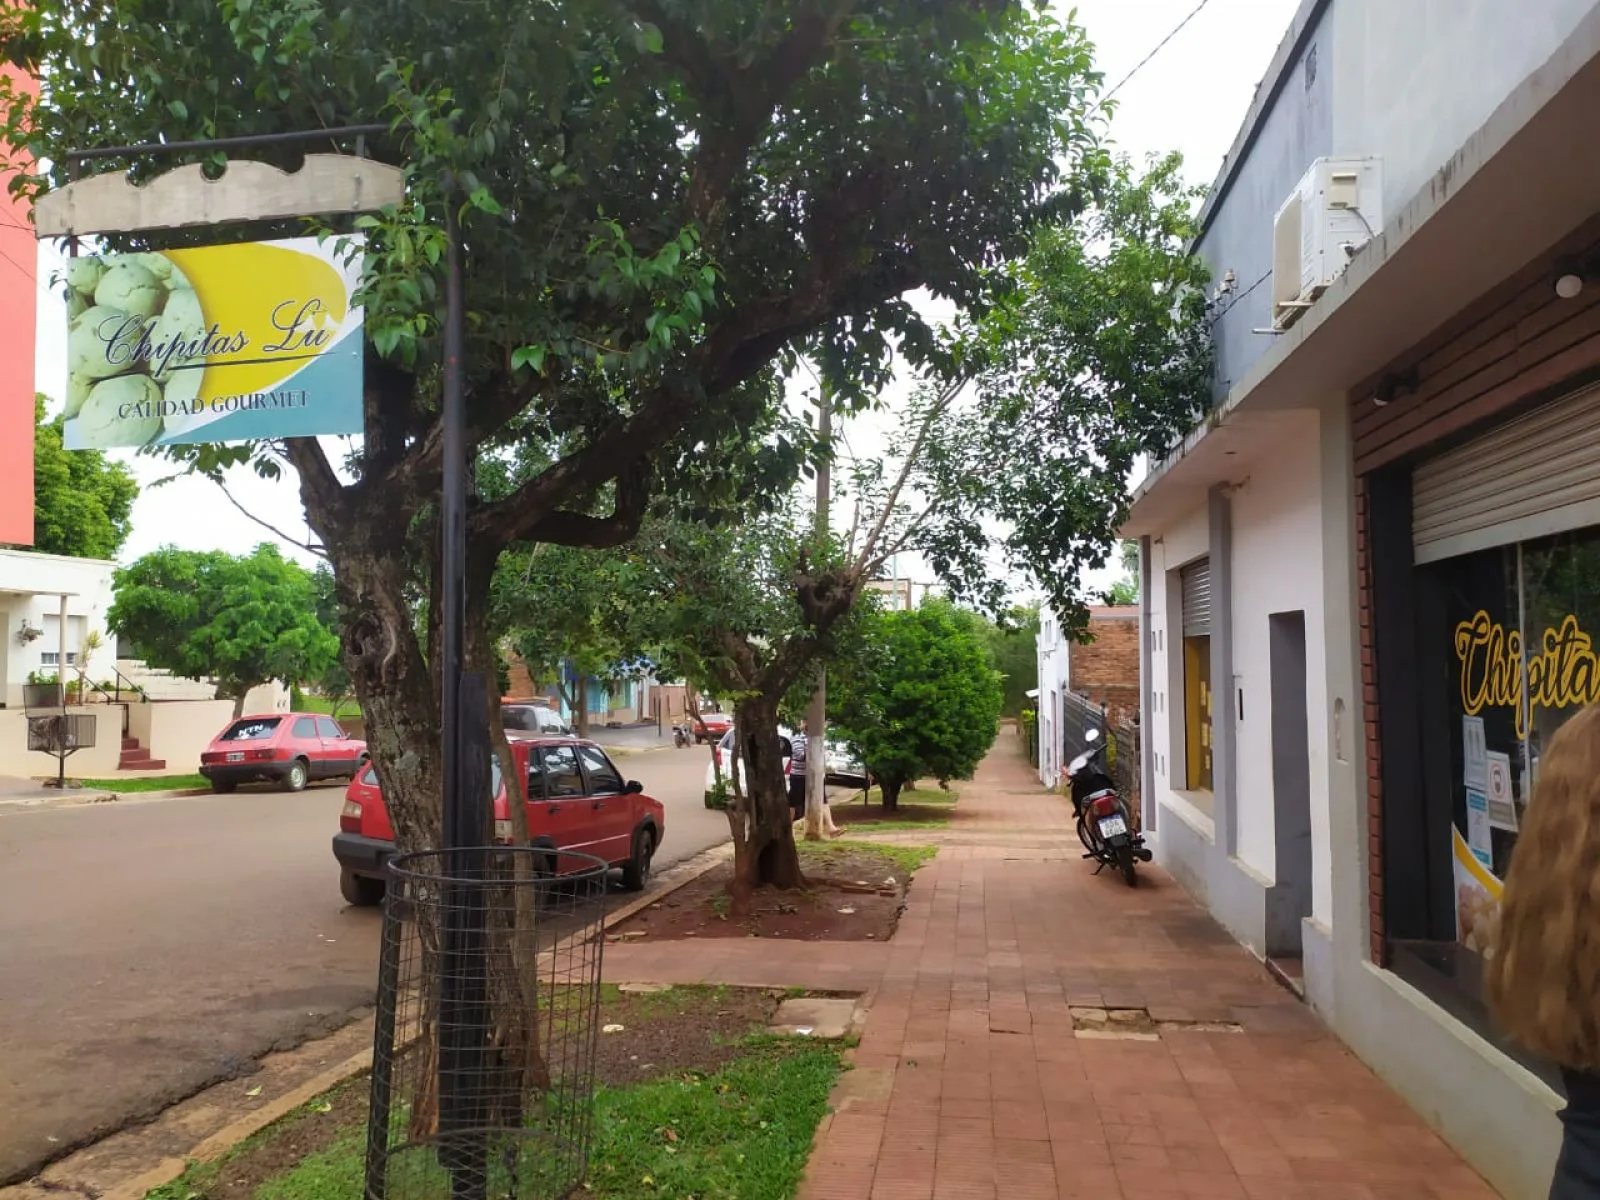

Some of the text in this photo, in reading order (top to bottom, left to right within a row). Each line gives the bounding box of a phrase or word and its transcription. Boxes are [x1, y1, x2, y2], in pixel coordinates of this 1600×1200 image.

[98, 298, 331, 378] Chipitas Lu
[118, 390, 308, 419] CALIDAD GOURMET
[1455, 609, 1600, 741] Chipita
